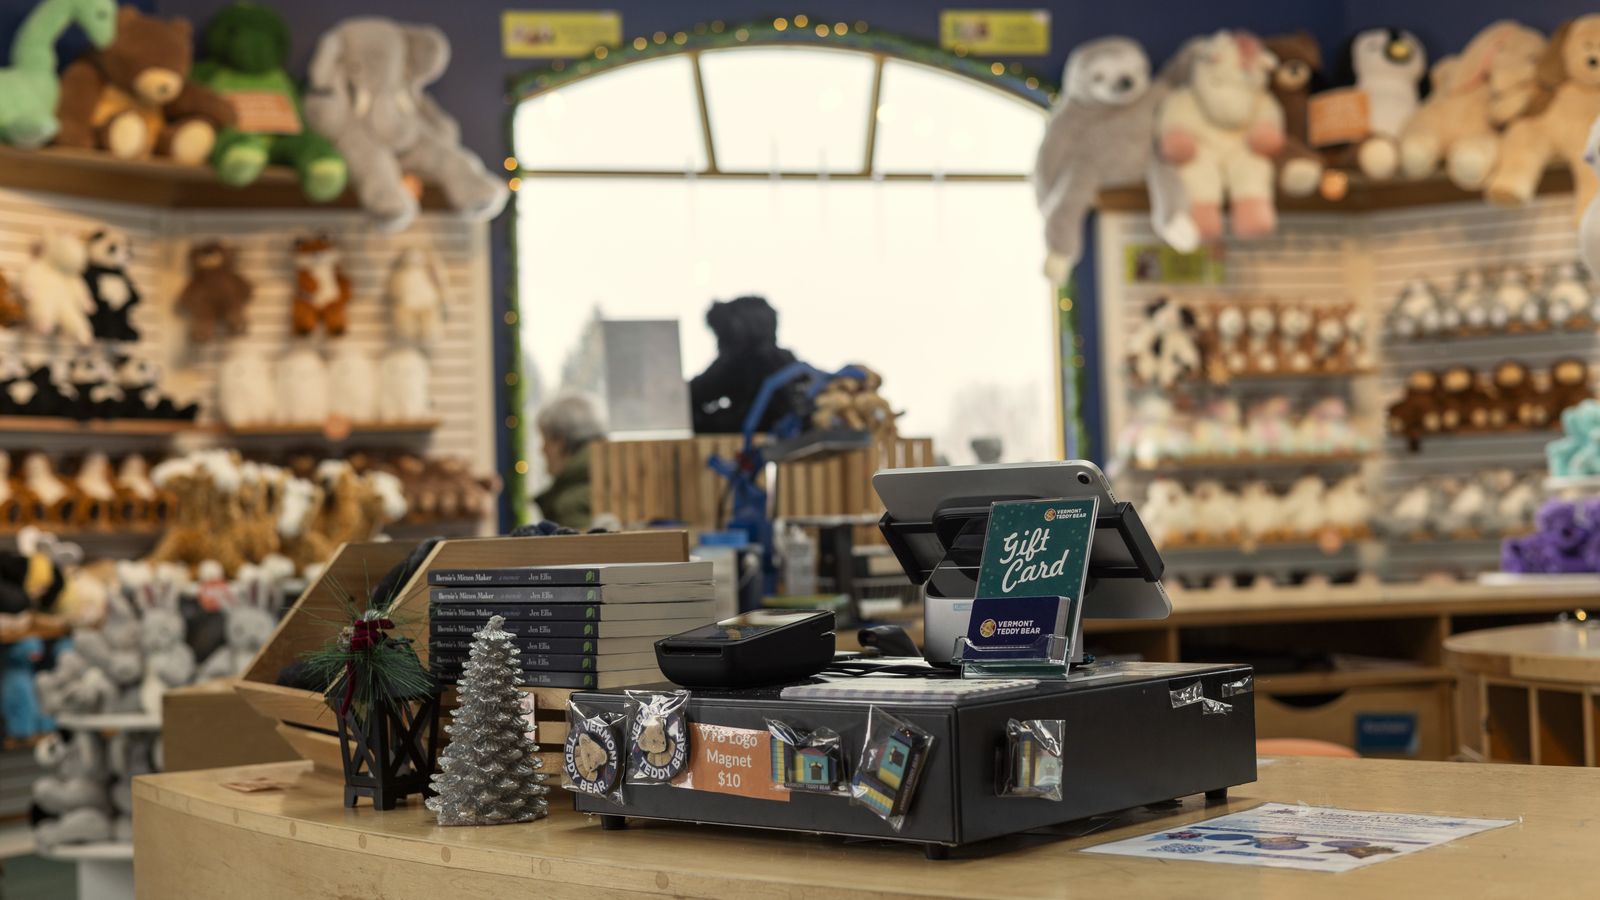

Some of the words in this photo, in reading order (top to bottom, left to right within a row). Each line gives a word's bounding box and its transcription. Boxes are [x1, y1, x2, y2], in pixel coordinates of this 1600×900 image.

[1000, 527, 1050, 565] Gift
[528, 573, 539, 581] Jen
[1002, 549, 1070, 593] Card
[583, 721, 617, 769] VERMONT
[640, 757, 671, 780] TEDDY
[672, 732, 685, 770] BEAR
[706, 748, 752, 768] Magnet
[729, 732, 758, 749] Logo
[566, 736, 580, 780] TEDDY
[580, 780, 606, 794] BEAR
[718, 770, 741, 788] $10
